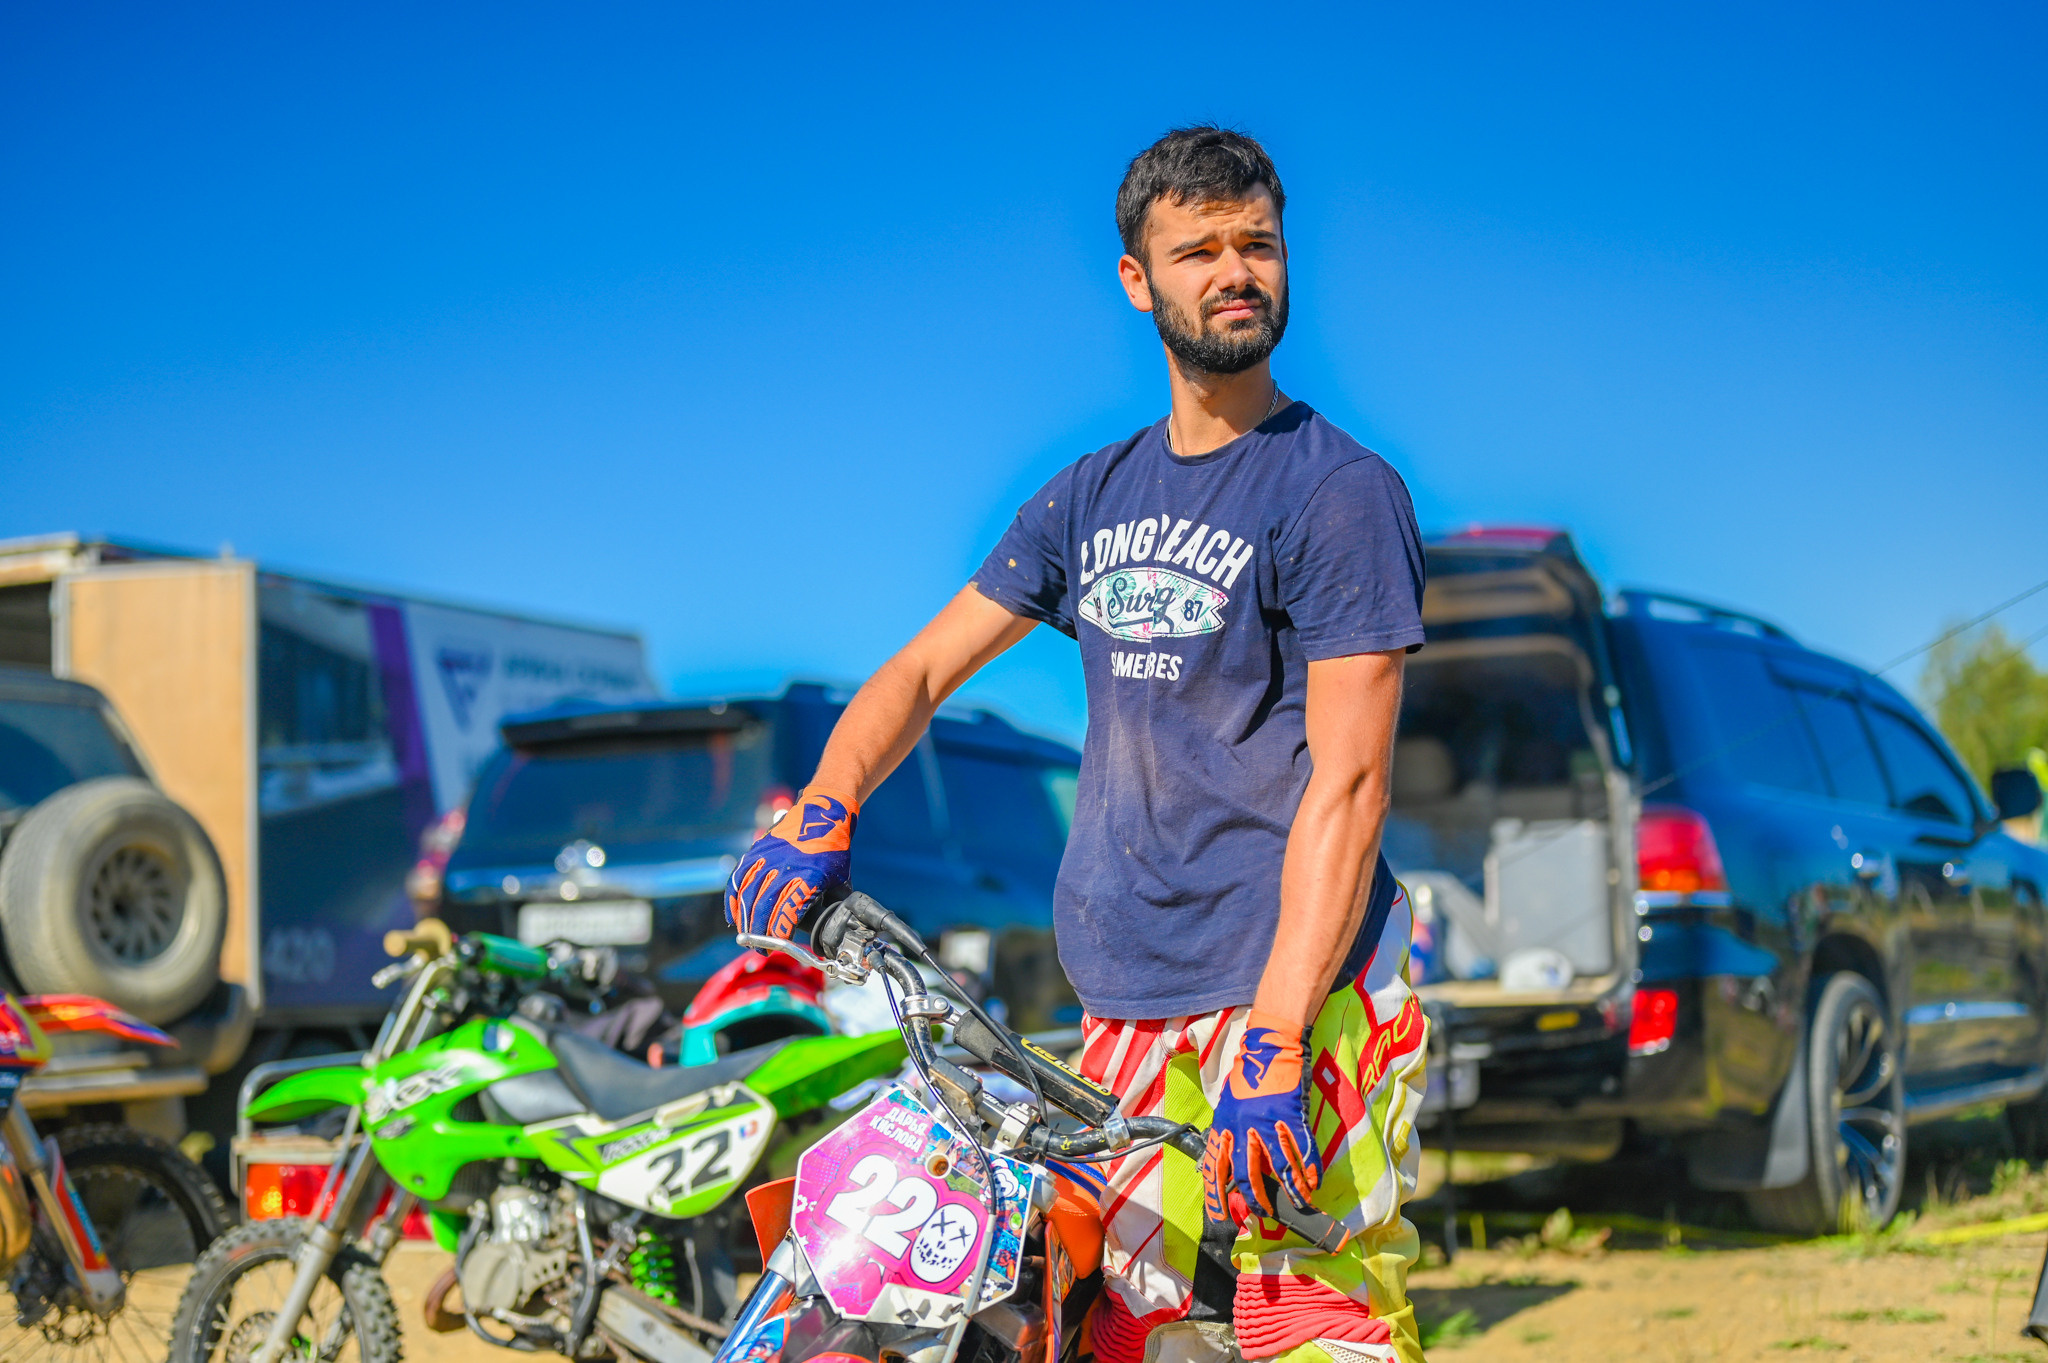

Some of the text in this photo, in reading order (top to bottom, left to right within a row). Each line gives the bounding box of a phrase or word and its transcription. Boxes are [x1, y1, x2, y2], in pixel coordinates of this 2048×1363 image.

[1080, 517, 1159, 585] LONG
[1183, 599, 1204, 622] 87
[869, 1114, 923, 1153] КИСЛОВА
[884, 1106, 928, 1137] ДАРЬЯ
[648, 1130, 730, 1205] 22
